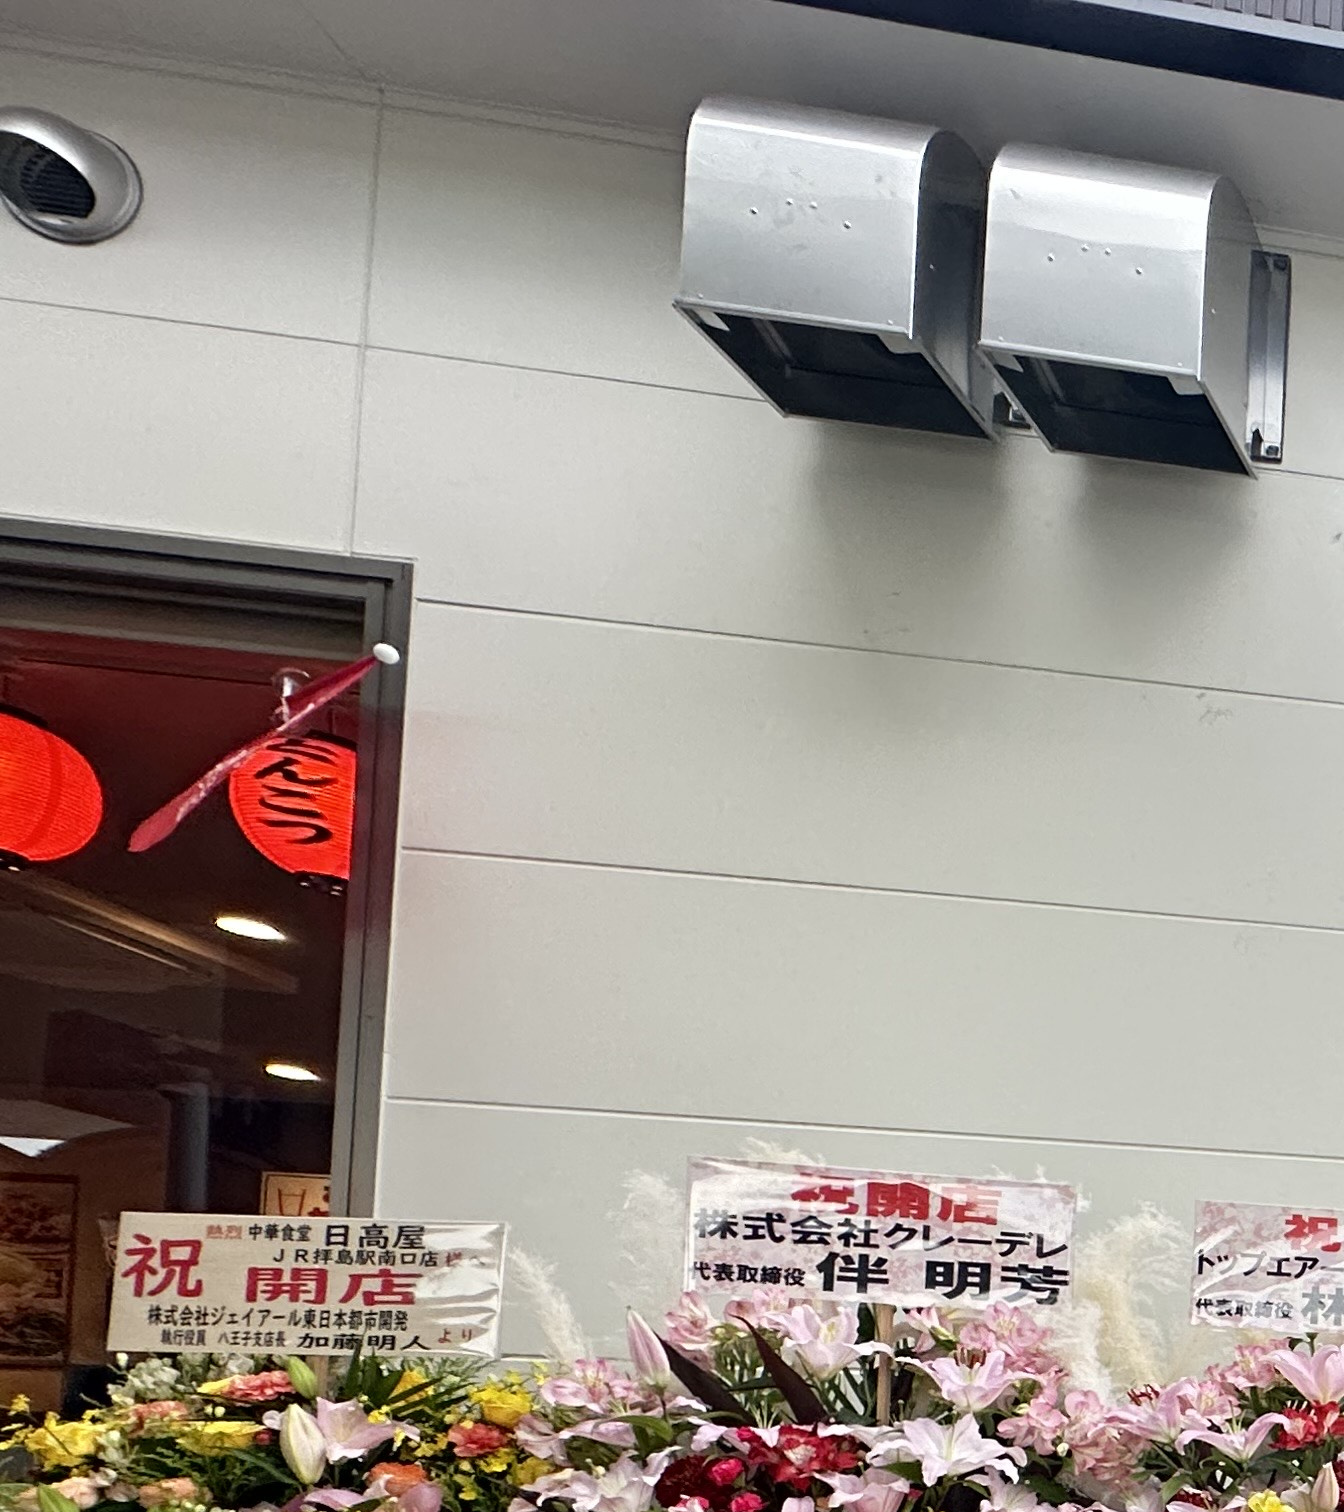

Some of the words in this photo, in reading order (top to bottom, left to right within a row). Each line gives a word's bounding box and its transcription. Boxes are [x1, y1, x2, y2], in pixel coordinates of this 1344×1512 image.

[248, 1224, 311, 1242] 中華食堂
[324, 1225, 426, 1250] 日高屋
[121, 1233, 204, 1299] 祝
[273, 1248, 438, 1267] JR拝島駅南口店
[693, 1262, 806, 1287] 代表取締役
[816, 1252, 889, 1294] 伴
[245, 1266, 423, 1305] 開店
[148, 1304, 408, 1333] 株式会社ジェイアール東日本都市開発
